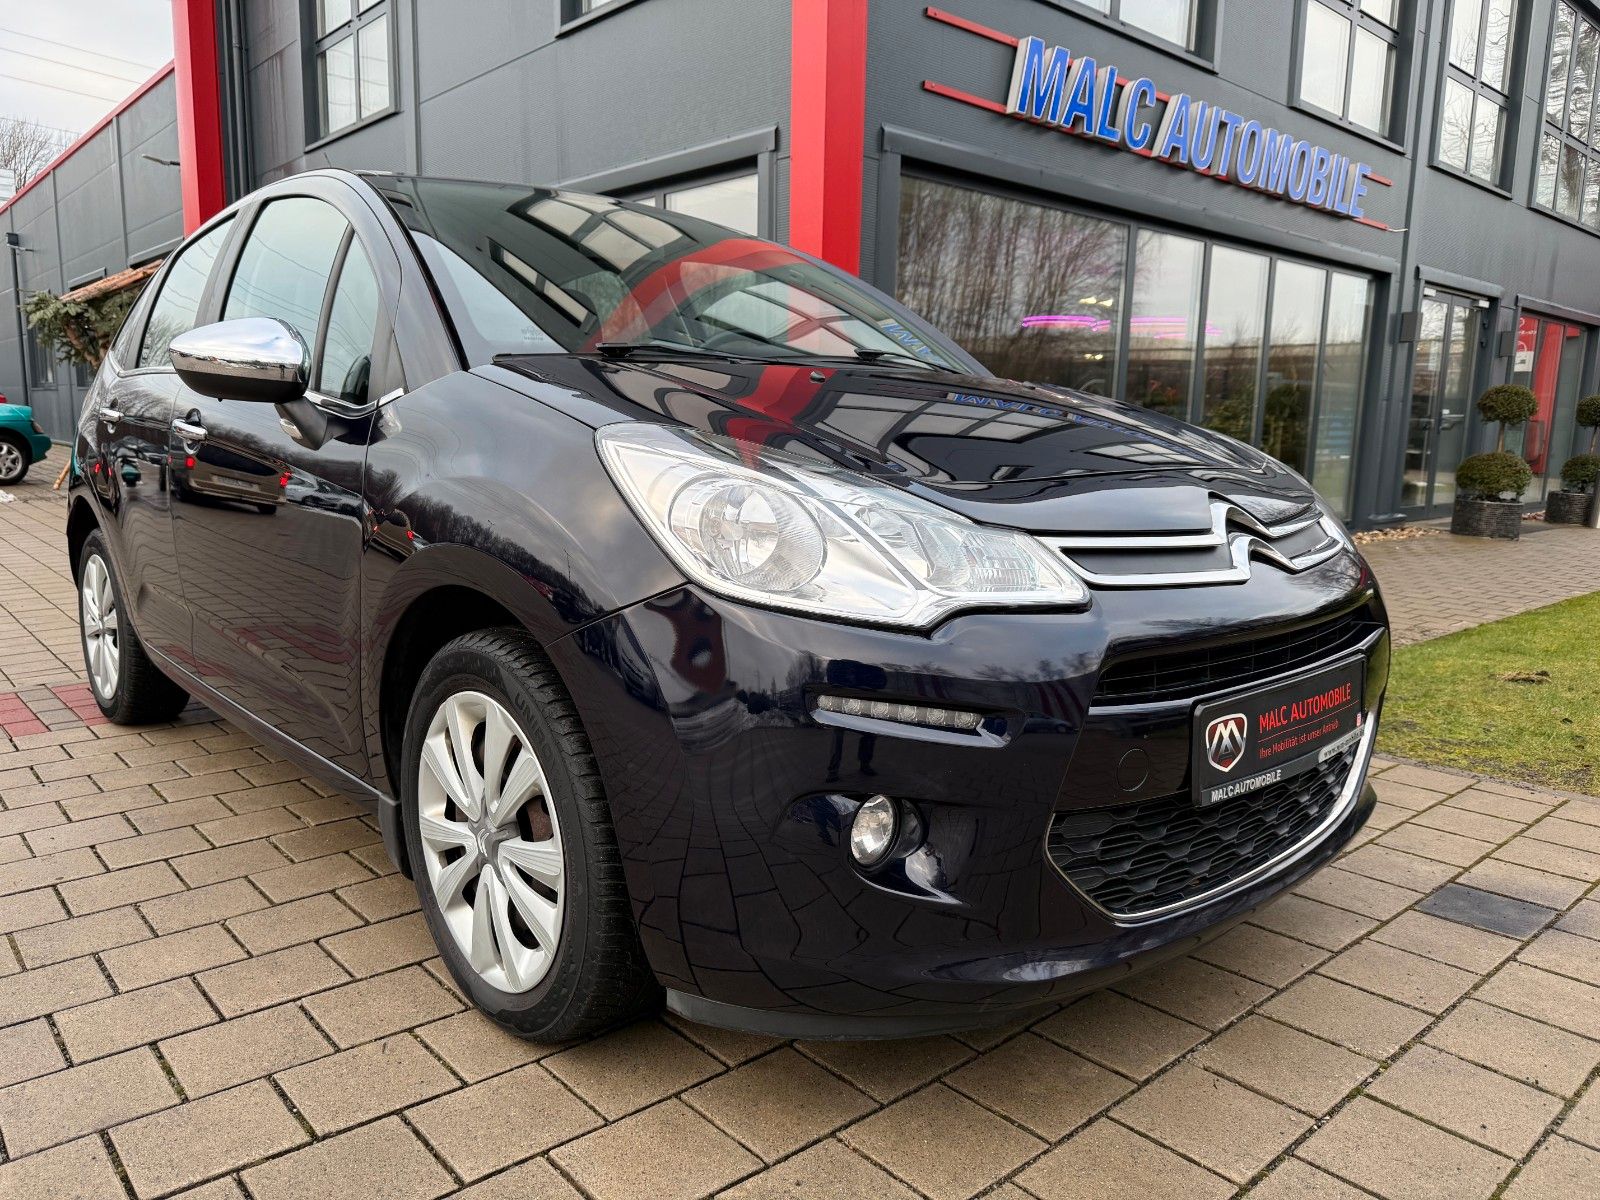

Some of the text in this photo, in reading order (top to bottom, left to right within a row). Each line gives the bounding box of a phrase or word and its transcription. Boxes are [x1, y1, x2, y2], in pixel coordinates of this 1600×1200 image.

[1011, 35, 1372, 219] MALC AUTOMOBILE
[1258, 682, 1352, 735] MALC AUTOMOBILE
